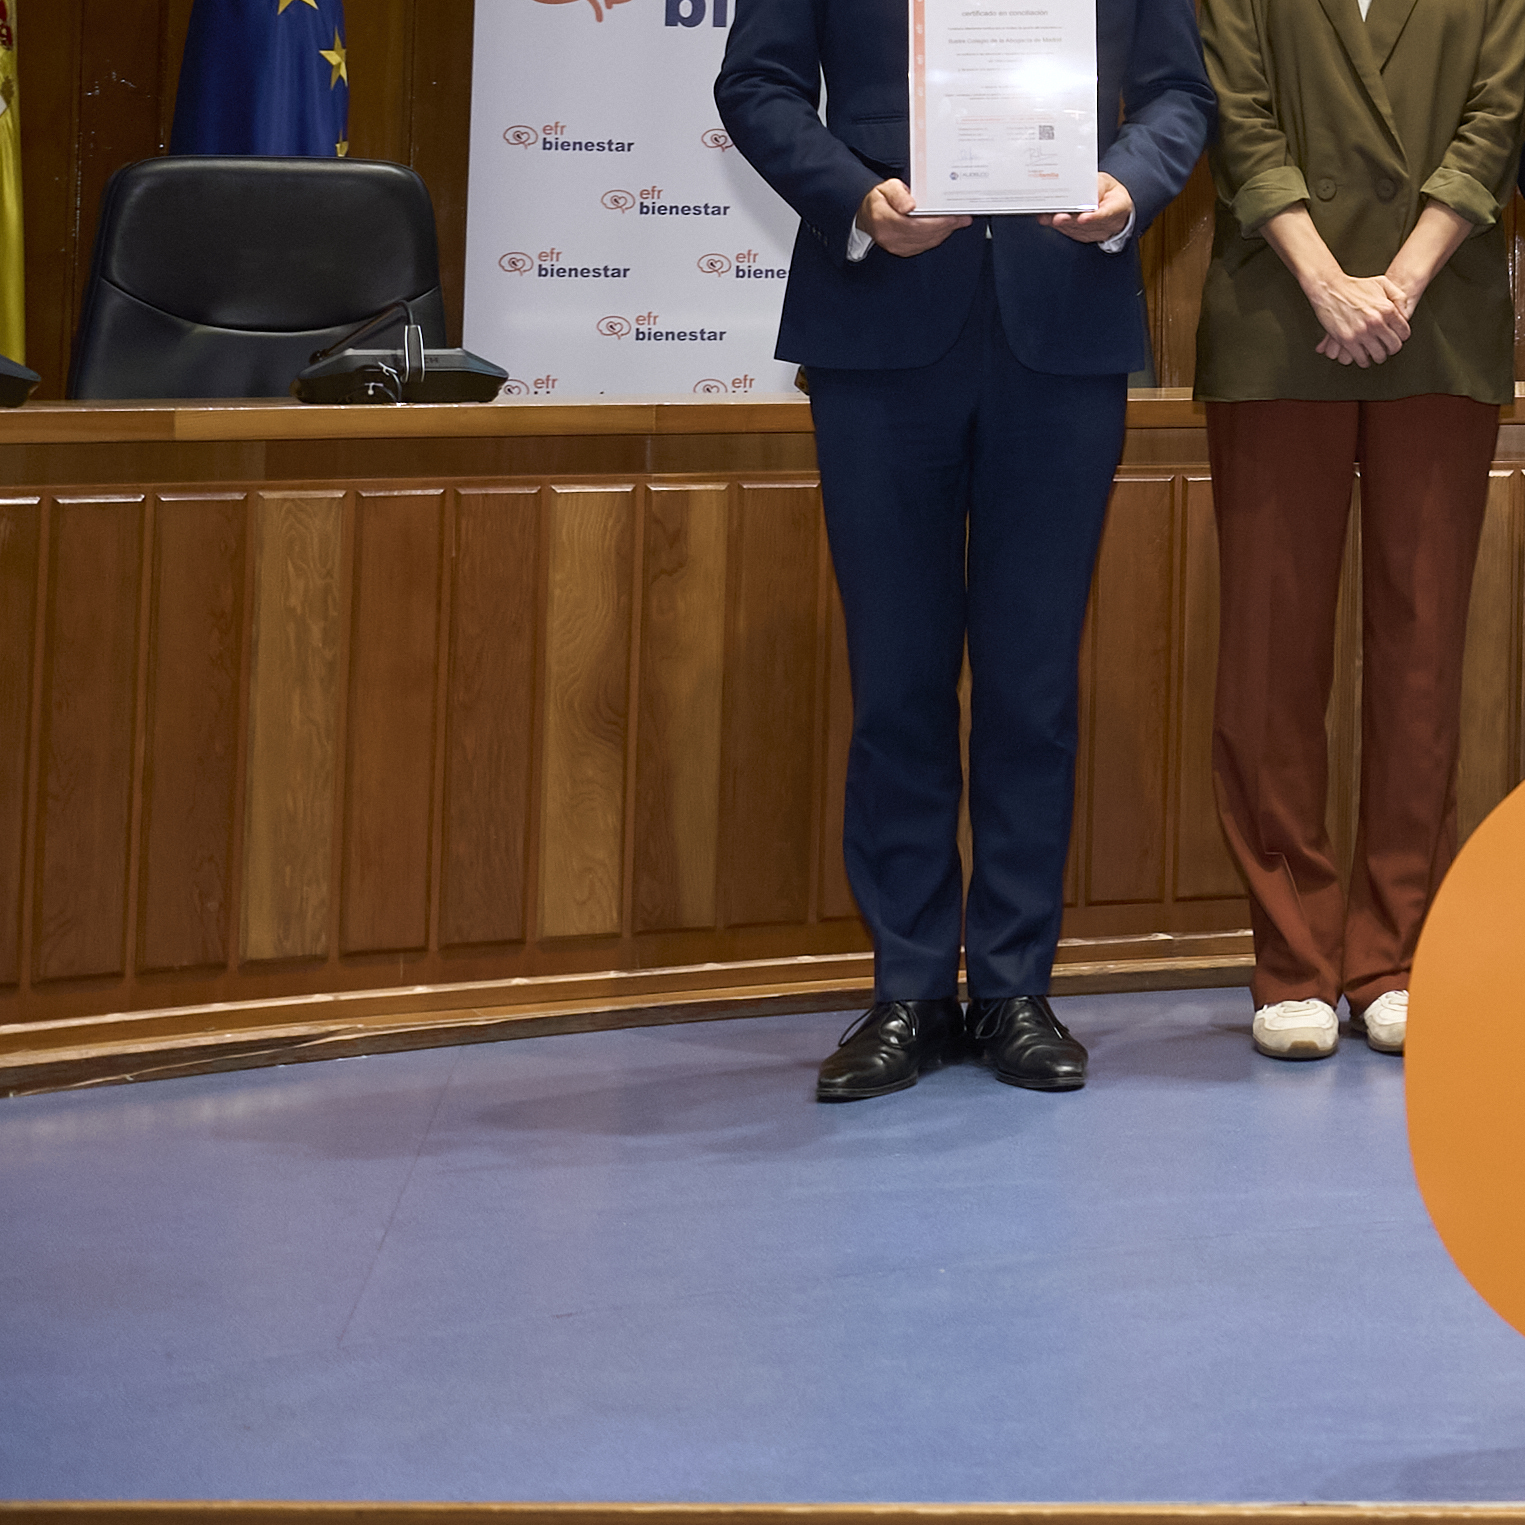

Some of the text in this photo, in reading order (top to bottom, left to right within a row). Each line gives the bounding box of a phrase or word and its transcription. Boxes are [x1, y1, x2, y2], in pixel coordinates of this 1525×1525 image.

[542, 121, 566, 135] efr
[542, 137, 634, 152] bienestar
[639, 185, 663, 200] efr
[639, 201, 730, 216] bienestar
[538, 248, 562, 262] efr
[735, 249, 758, 263] efr
[538, 263, 630, 278] bienestar
[736, 266, 787, 278] biene
[635, 311, 659, 326] efr
[635, 328, 726, 341] bienestar
[533, 375, 557, 389] efr
[732, 374, 755, 388] efr
